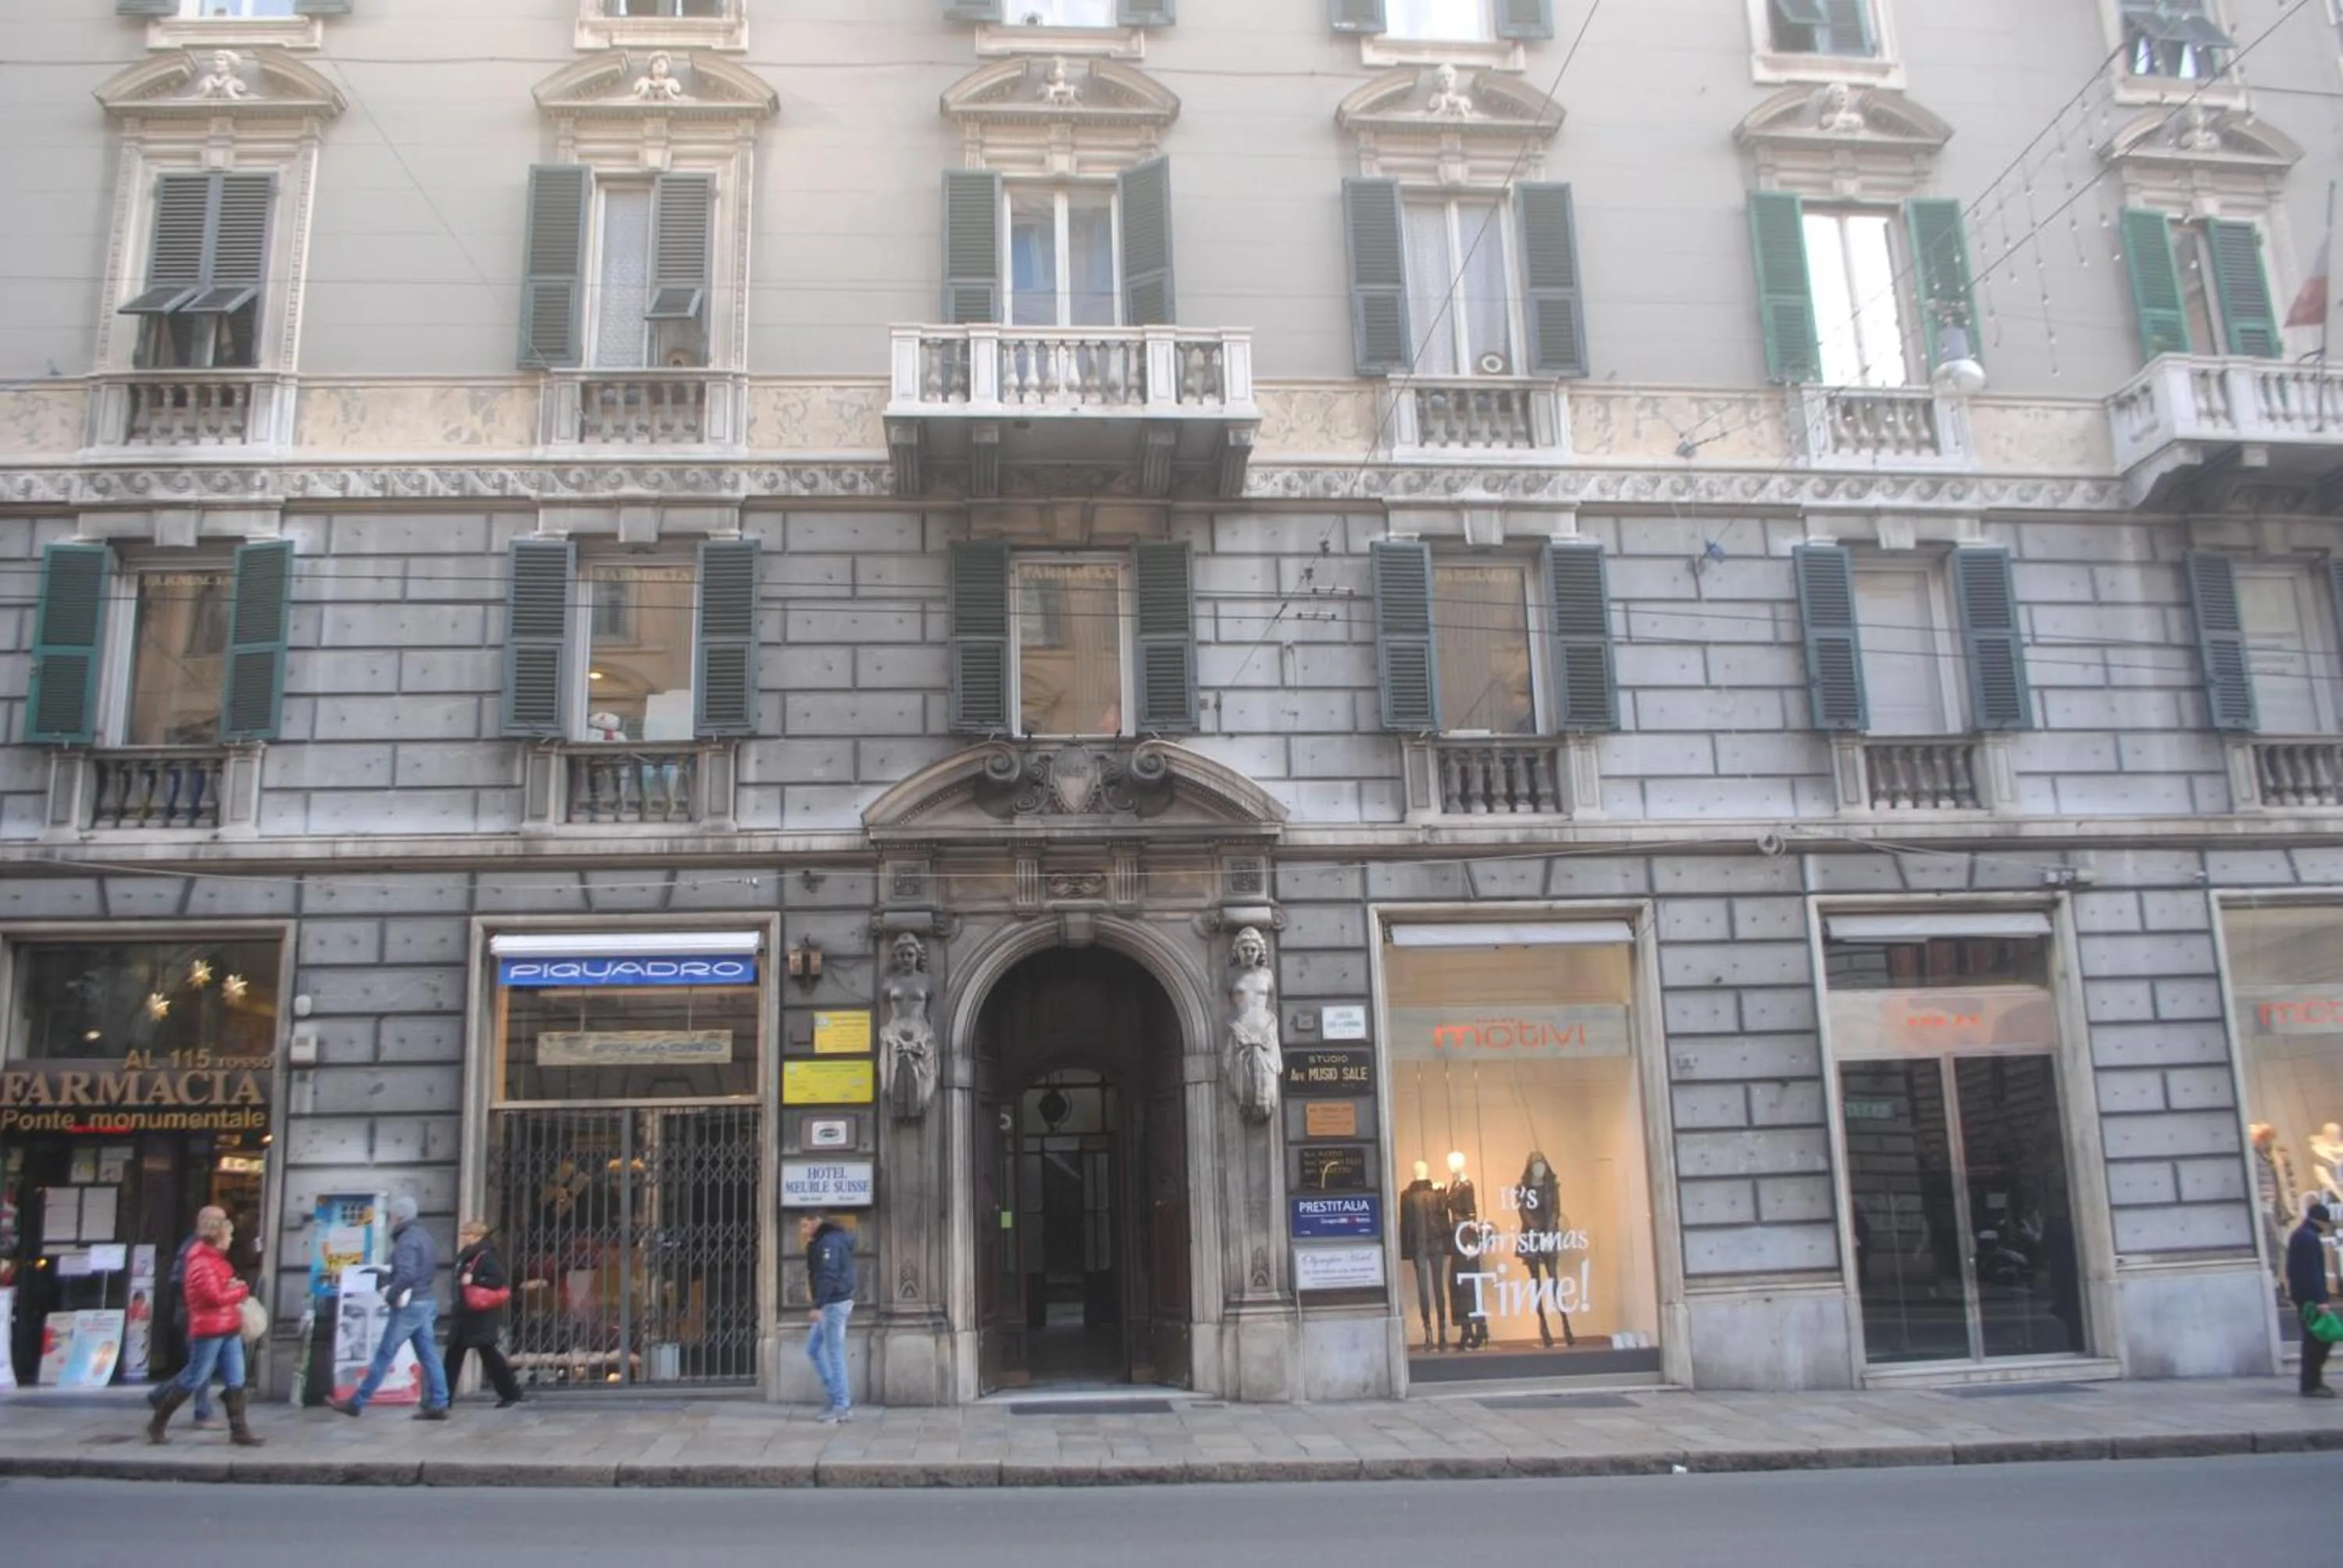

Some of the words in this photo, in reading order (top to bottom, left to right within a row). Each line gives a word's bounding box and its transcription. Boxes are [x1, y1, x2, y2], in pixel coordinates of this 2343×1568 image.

[509, 961, 744, 979] PIQUADRO
[1434, 1022, 1585, 1049] motivi
[123, 1049, 157, 1069] AL
[169, 1049, 210, 1069] 115
[1343, 1066, 1368, 1081] SALE
[1, 1070, 264, 1106] FARMACIA
[2, 1109, 75, 1130] Ponte
[88, 1107, 266, 1129] monumentale
[807, 1167, 847, 1179] HOTEL
[833, 1179, 869, 1193] SUISSE
[1299, 1199, 1369, 1213] PRESTITALIA
[1500, 1186, 1539, 1210] It's
[1455, 1220, 1589, 1257] Christmas
[1457, 1258, 1591, 1318] Time!
